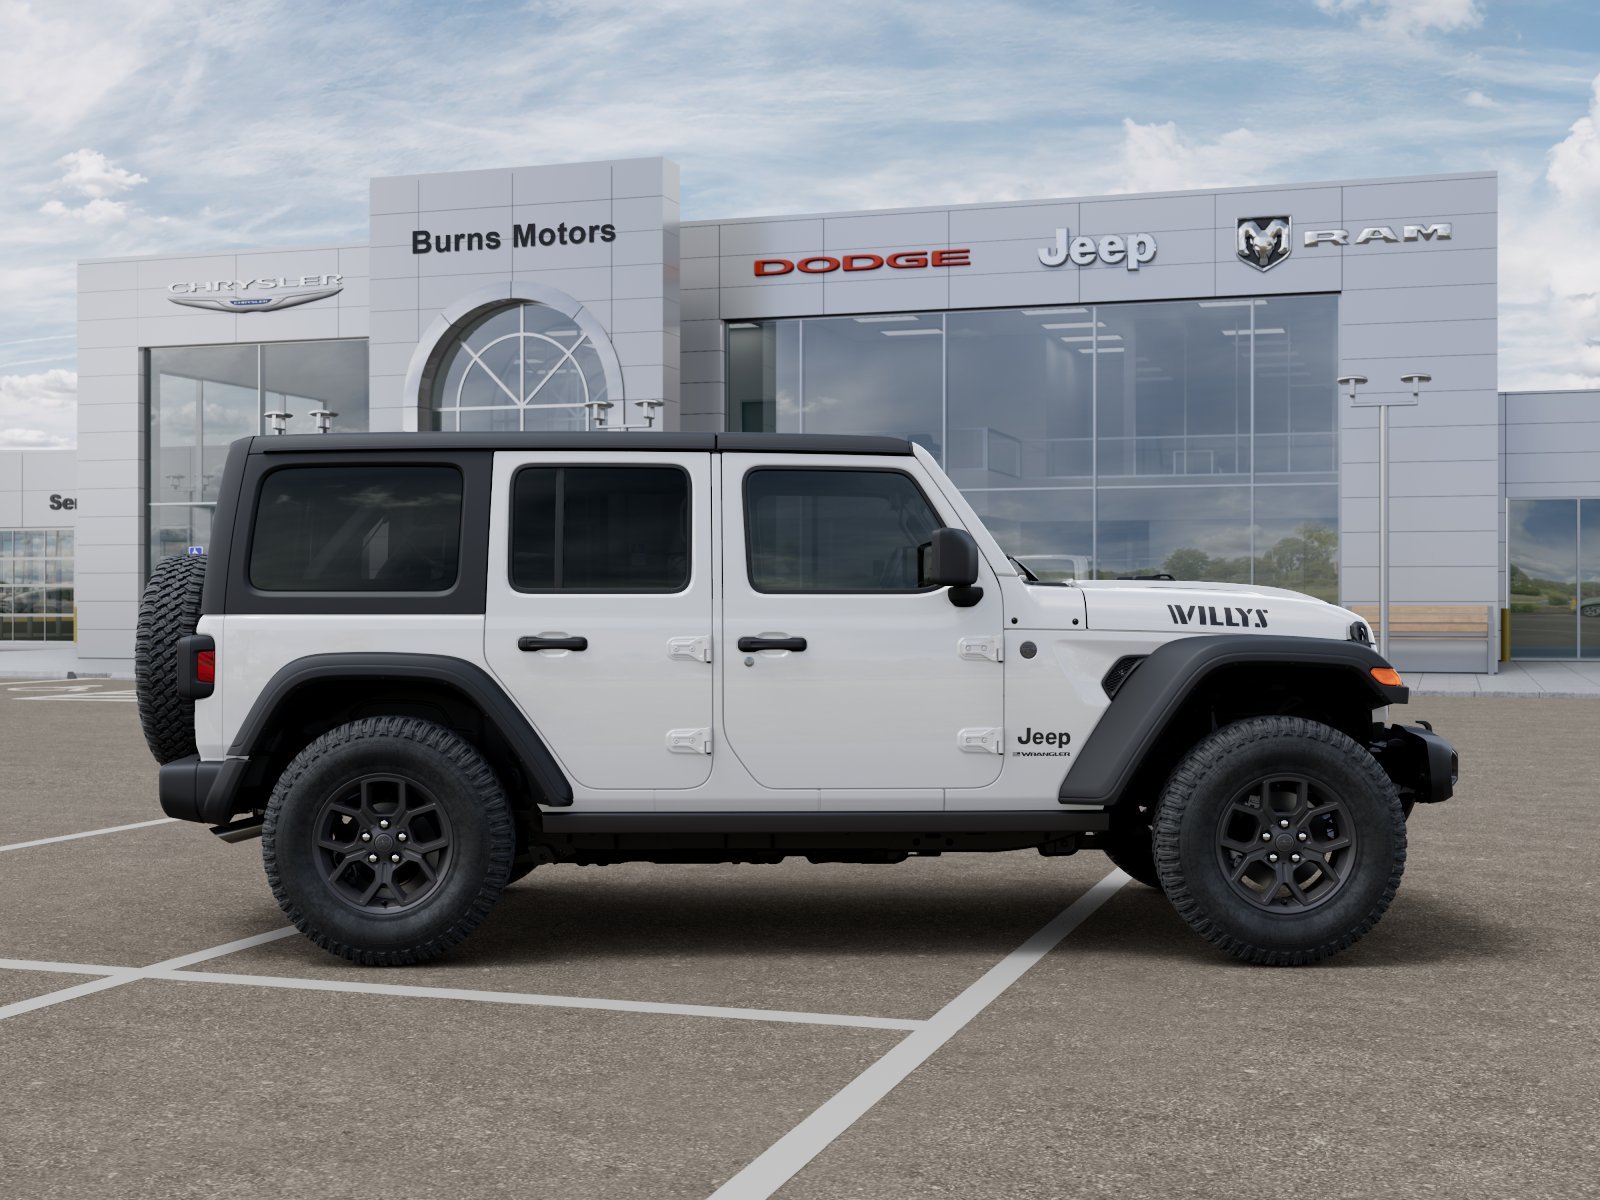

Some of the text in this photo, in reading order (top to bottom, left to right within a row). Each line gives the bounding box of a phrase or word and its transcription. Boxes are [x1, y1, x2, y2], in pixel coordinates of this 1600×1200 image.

[412, 222, 617, 254] Burns Motors
[1304, 223, 1452, 248] RAM
[1038, 227, 1157, 272] Jeep
[754, 249, 971, 277] DODGE
[167, 274, 343, 294] CHRYSLER
[1167, 604, 1269, 628] WILLYS
[1017, 727, 1071, 748] Jeep
